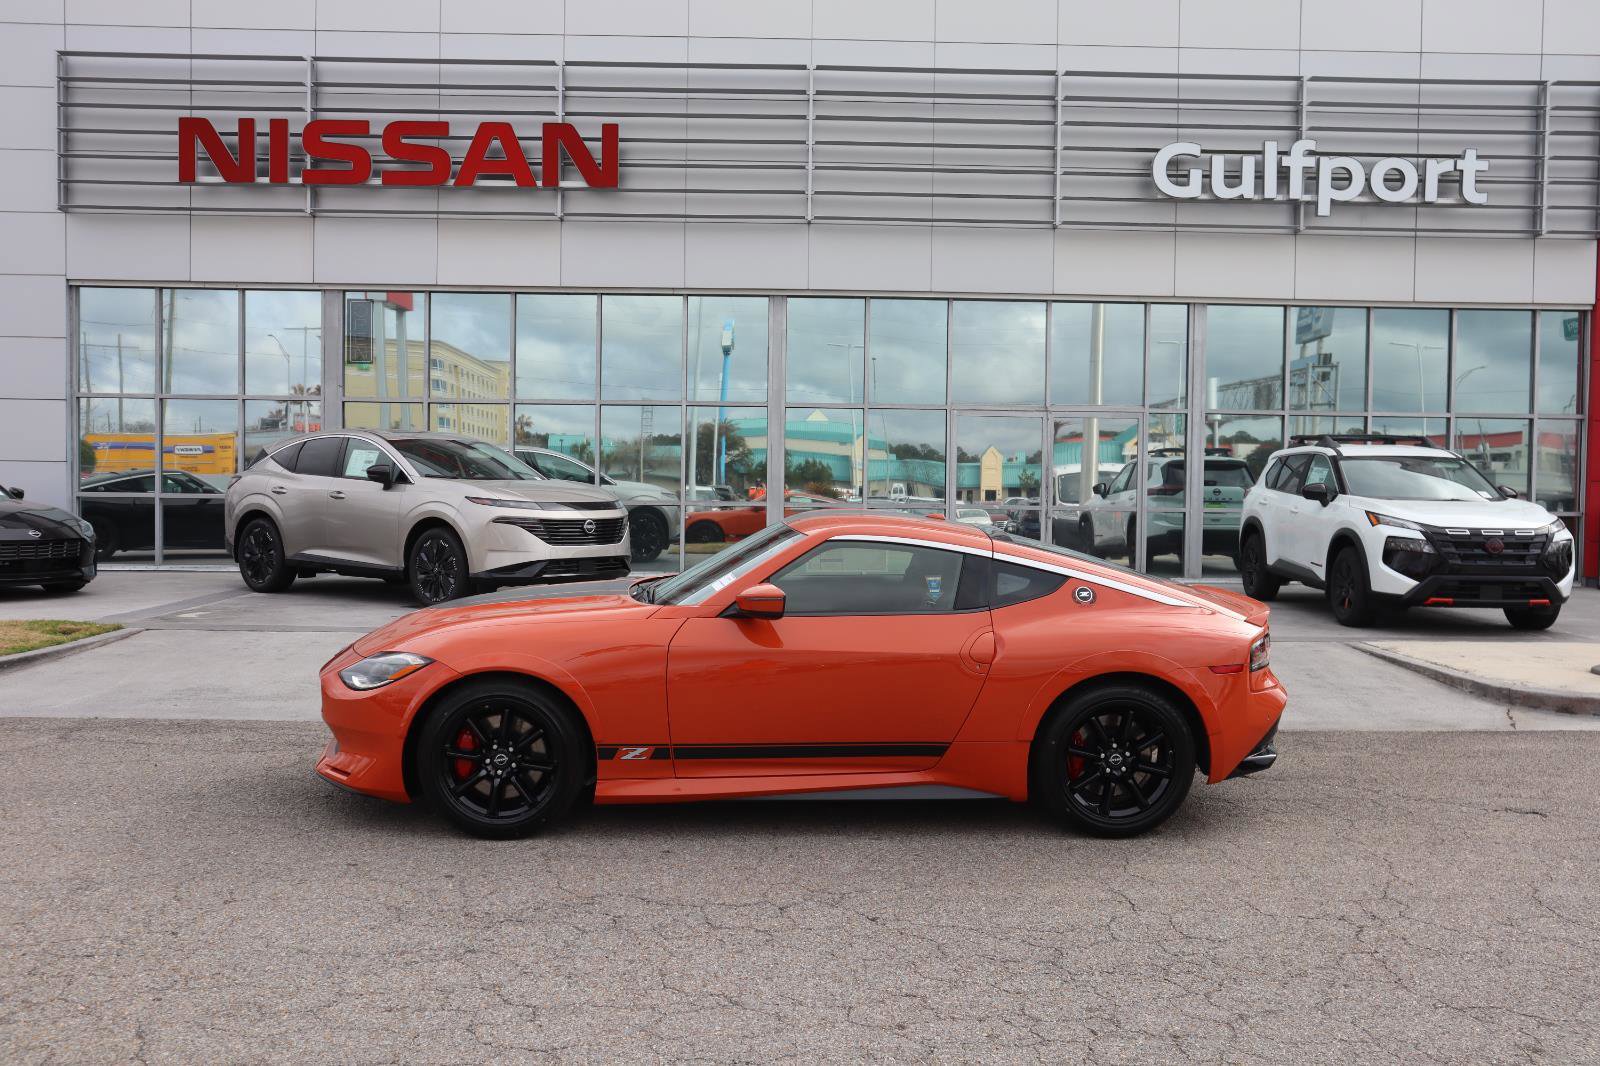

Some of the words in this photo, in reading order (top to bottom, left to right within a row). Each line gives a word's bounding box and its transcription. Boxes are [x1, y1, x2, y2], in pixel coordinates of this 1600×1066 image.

[179, 117, 619, 188] NISSAN
[1152, 139, 1490, 217] Gulfport
[620, 747, 649, 760] Z
